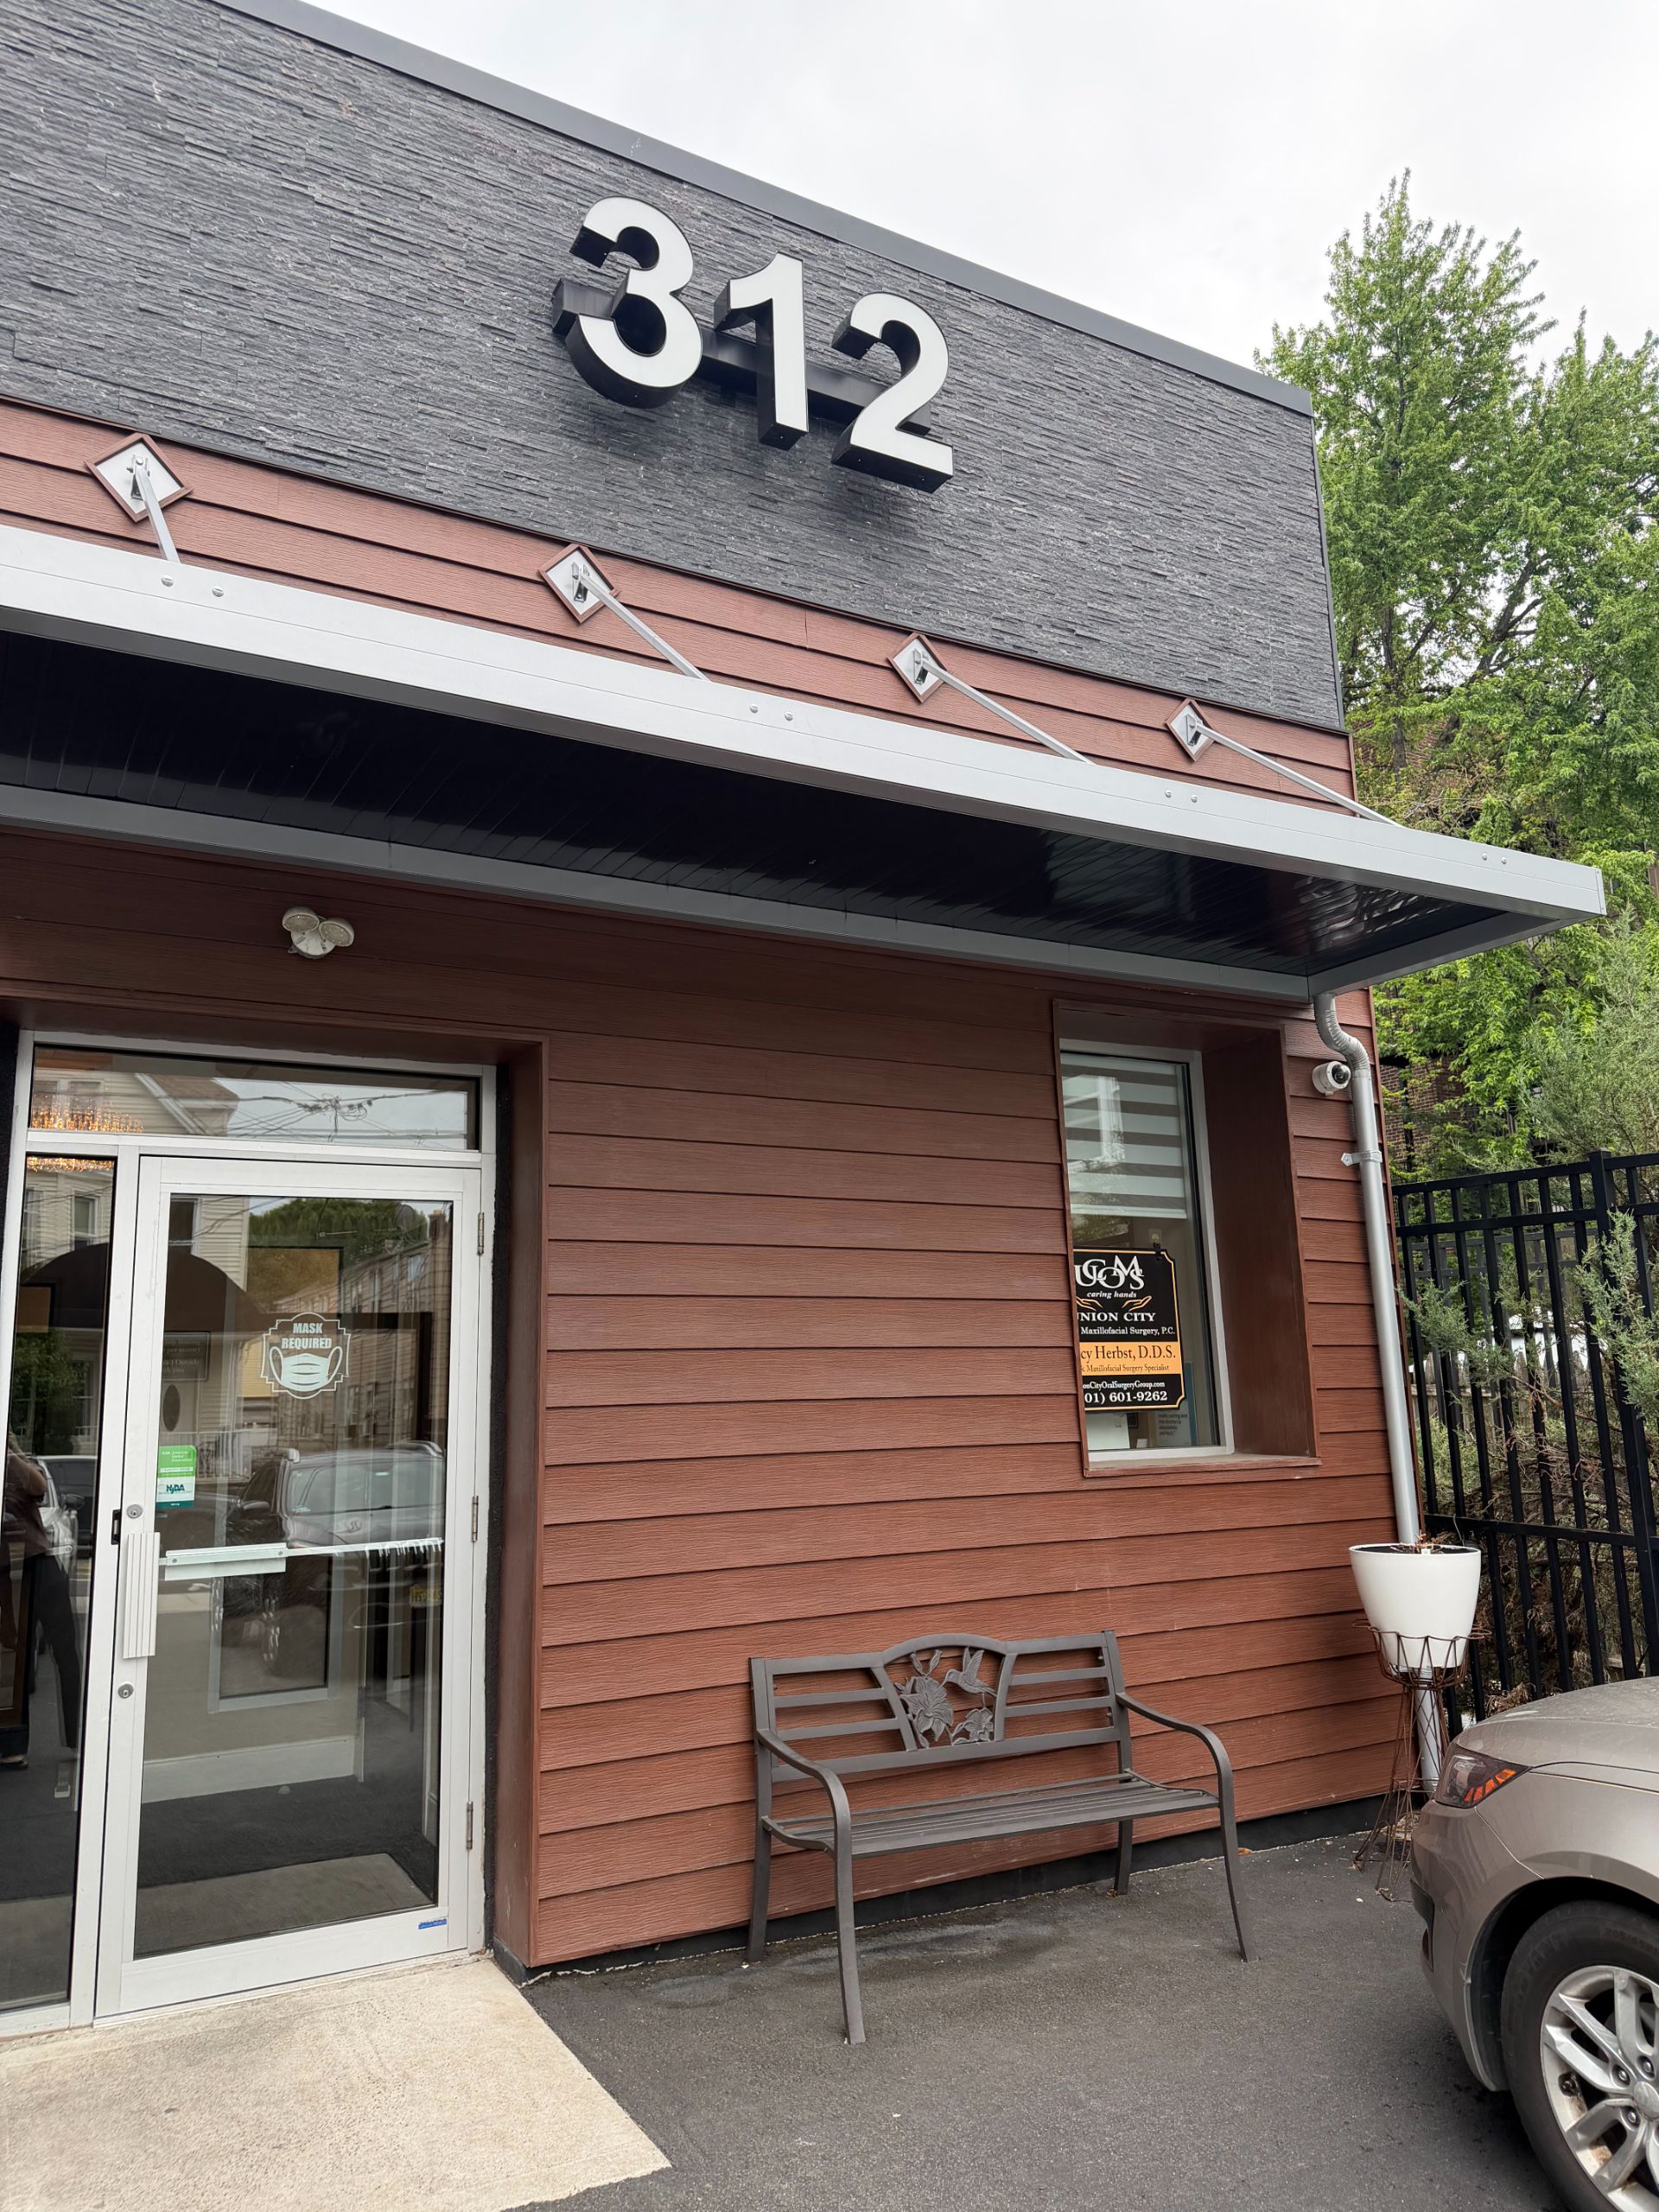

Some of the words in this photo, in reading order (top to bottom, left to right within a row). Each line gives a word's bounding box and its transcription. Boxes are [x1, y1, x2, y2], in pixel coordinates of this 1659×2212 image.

[576, 195, 954, 479] 312
[1086, 1290, 1112, 1299] caring
[1077, 1312, 1119, 1322] NION
[1123, 1312, 1156, 1322] CITY
[293, 1323, 323, 1333] MASK
[1080, 1326, 1128, 1335] Maxillofacial
[1129, 1326, 1160, 1336] Surgery,
[1161, 1326, 1176, 1335] P.C.
[281, 1338, 333, 1350] REQUIRED
[1095, 1345, 1136, 1361] Herbst,
[1137, 1344, 1176, 1359] D.D.S.
[1122, 1364, 1144, 1373] Surgery
[1144, 1363, 1170, 1373] Specialist
[1109, 1390, 1168, 1402] 601-9262
